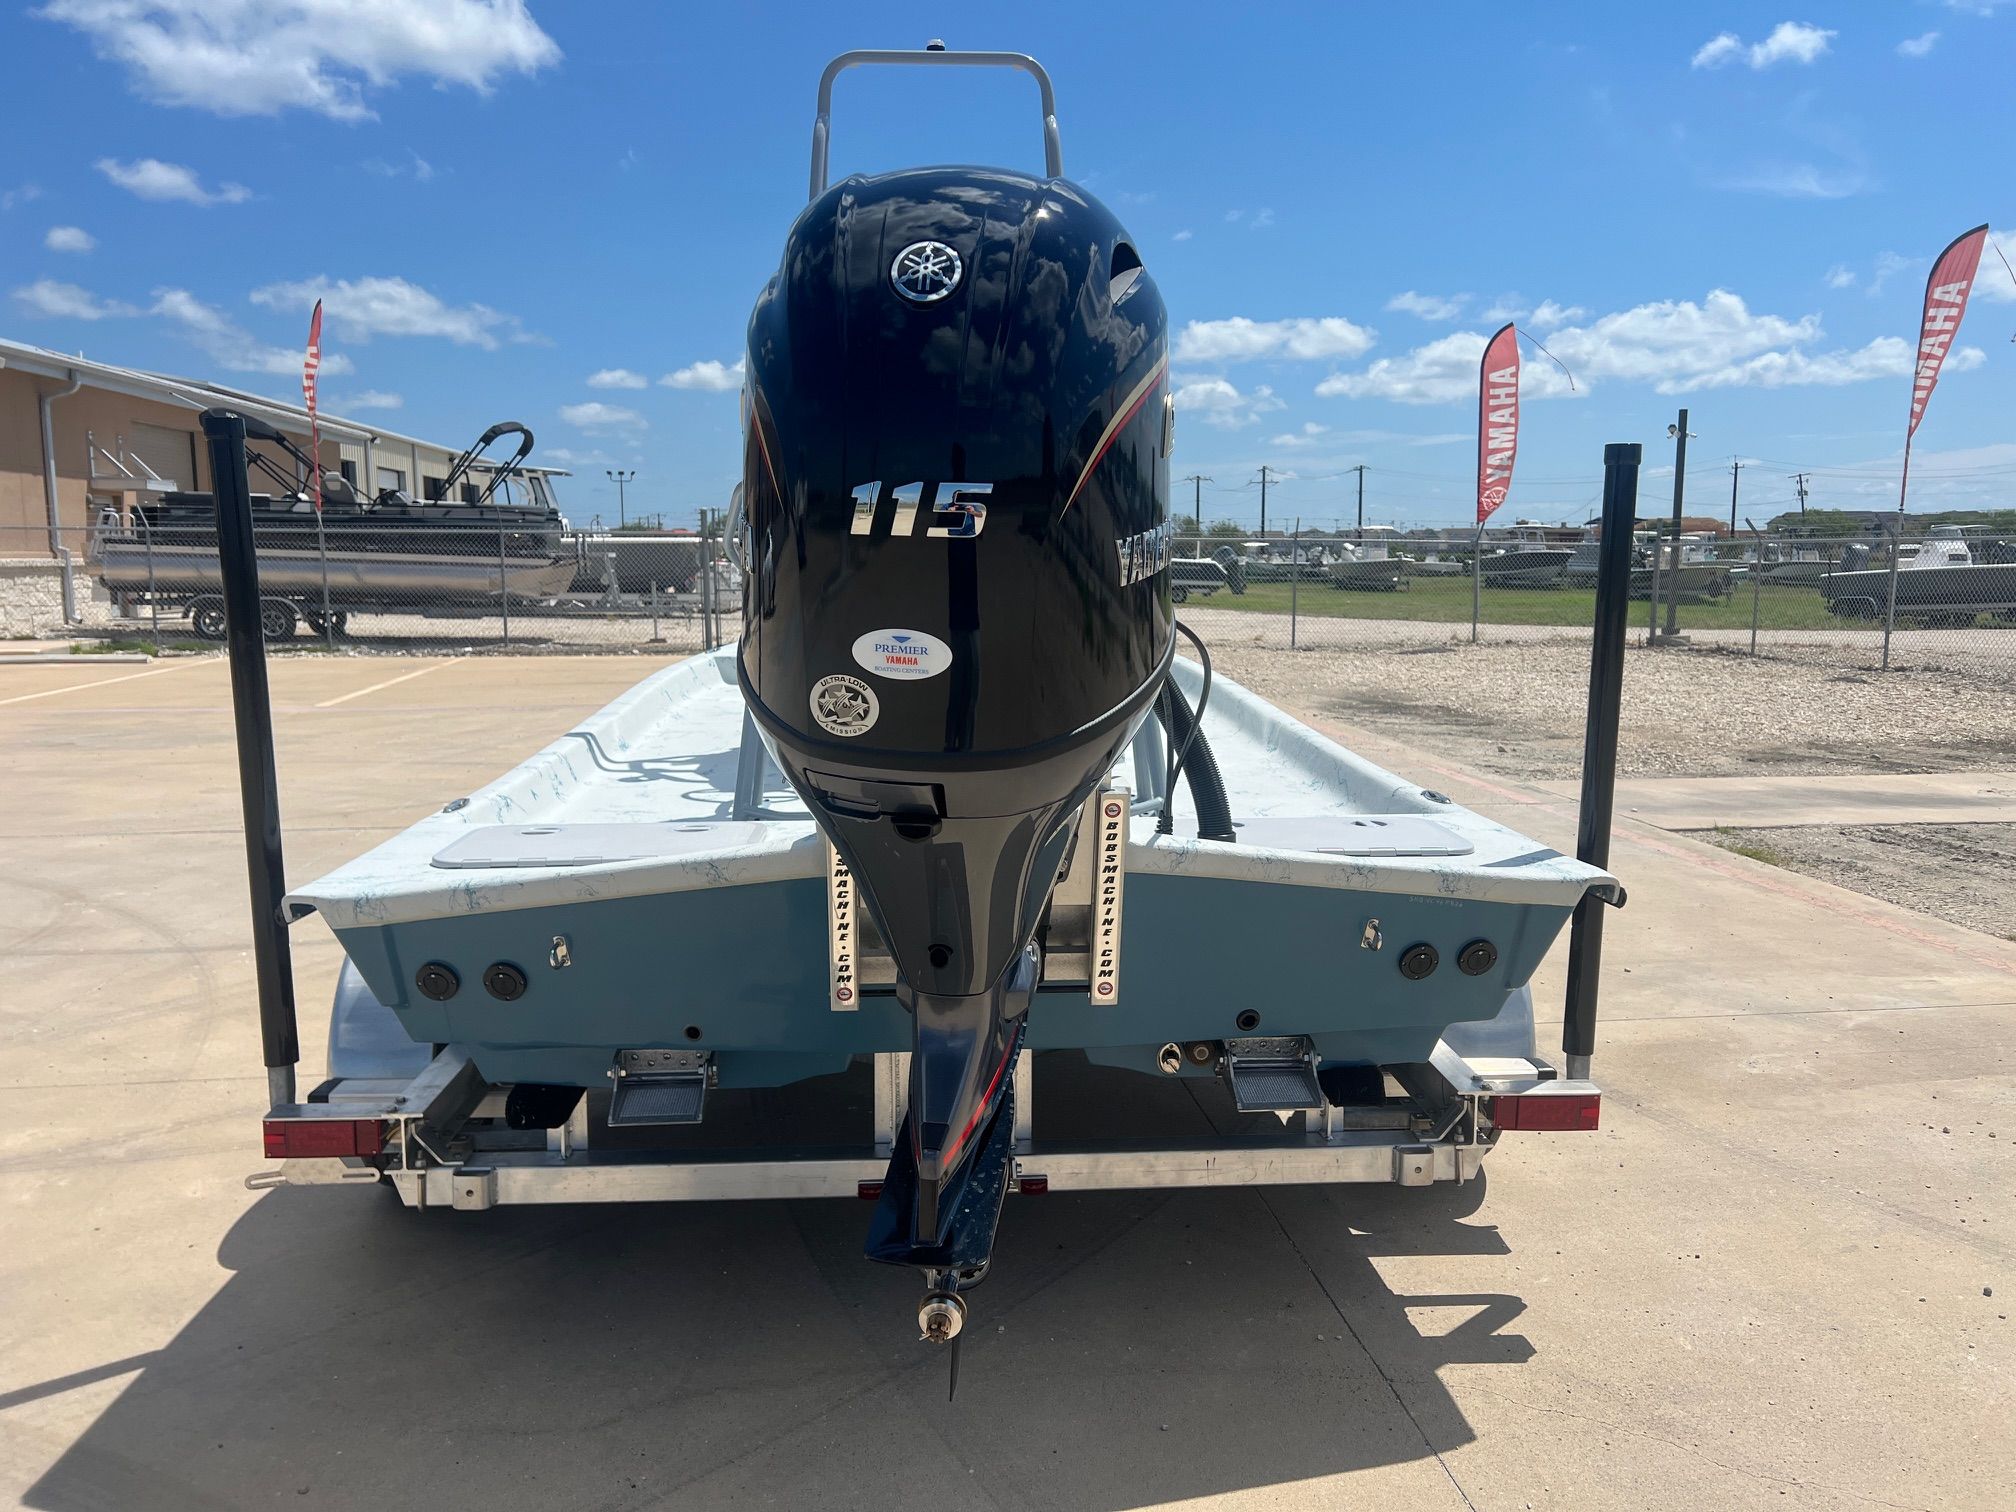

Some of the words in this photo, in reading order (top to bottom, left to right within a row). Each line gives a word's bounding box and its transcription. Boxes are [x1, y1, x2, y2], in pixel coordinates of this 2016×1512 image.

[1911, 280, 1968, 428] MAHA
[1486, 365, 1517, 484] YAMAHA
[850, 480, 994, 538] 115
[874, 643, 928, 656] PREMIER
[885, 655, 918, 666] YAMAHA
[874, 665, 901, 673] BOATING
[902, 667, 929, 675] CENTERS
[825, 723, 863, 735] EMISSION
